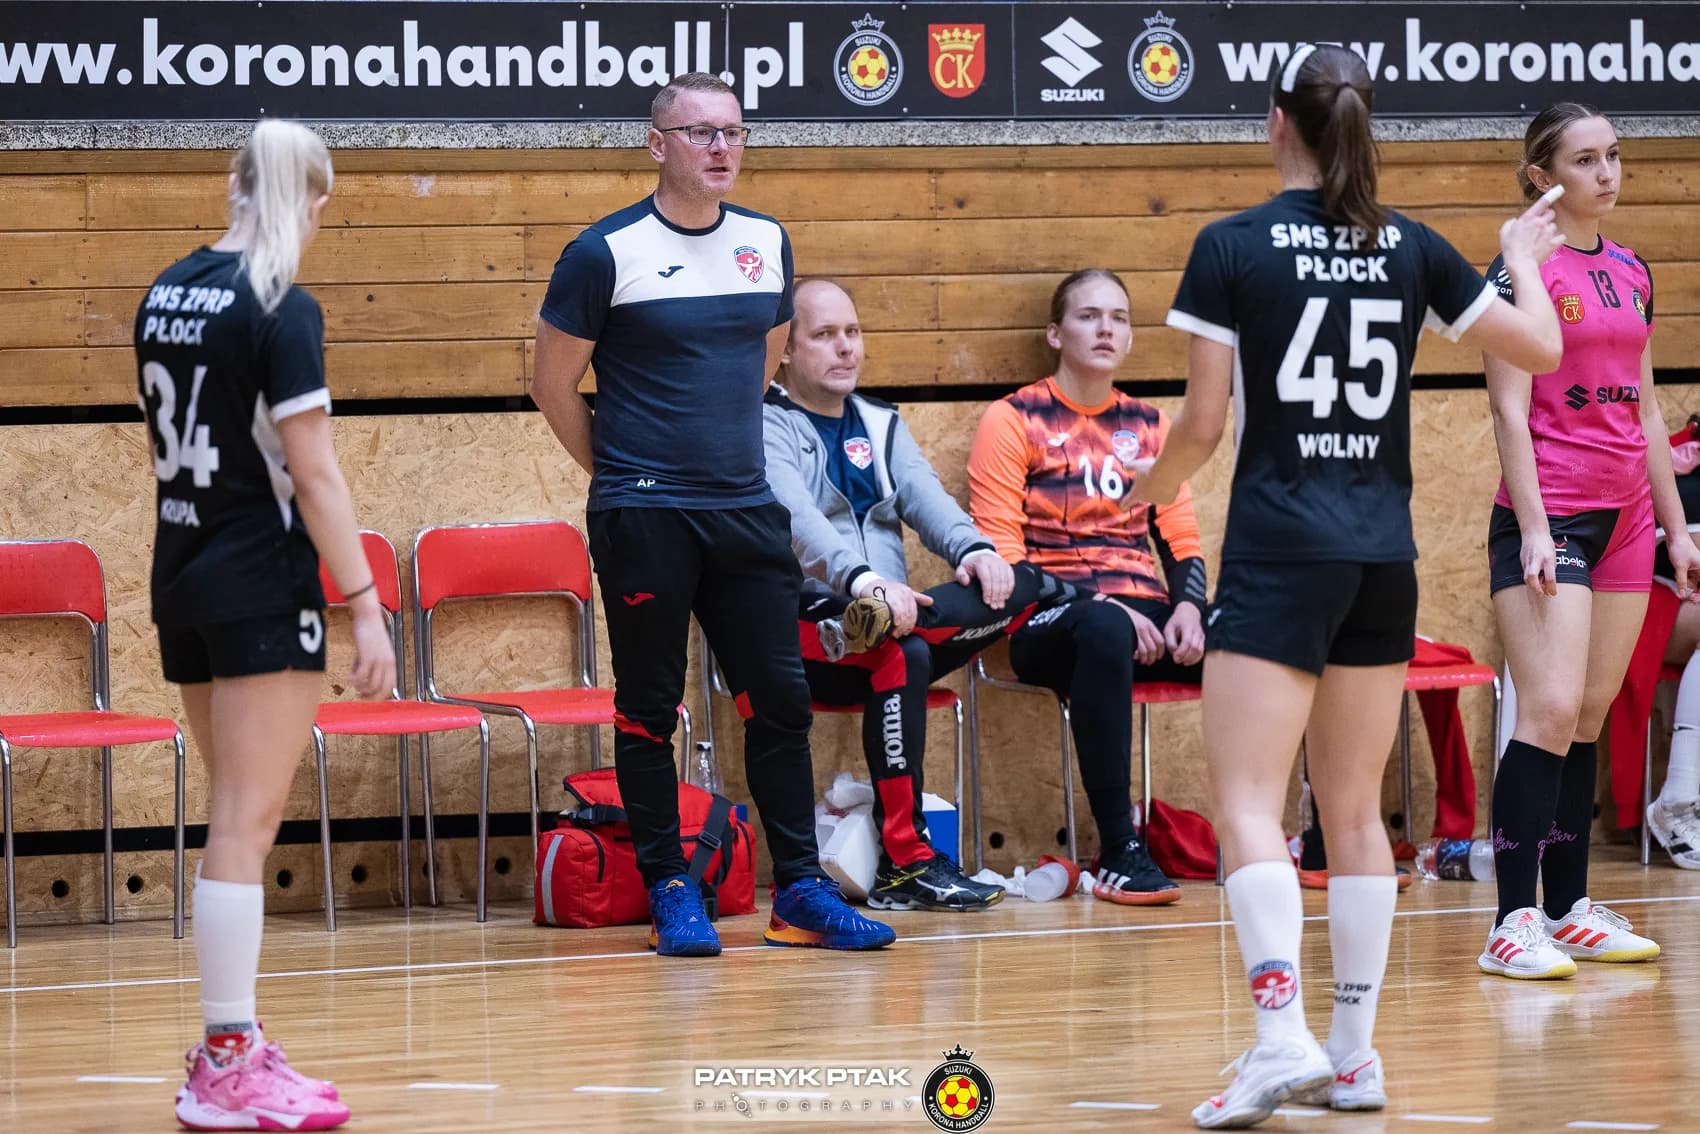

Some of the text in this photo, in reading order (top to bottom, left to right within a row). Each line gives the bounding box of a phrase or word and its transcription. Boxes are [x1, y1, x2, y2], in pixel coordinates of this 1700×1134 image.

[854, 36, 882, 47] SUZUKI
[934, 53, 975, 89] CK
[1134, 69, 1189, 96] KORONA HANDBALL
[840, 72, 897, 99] KORONA HANDBALL
[1040, 88, 1105, 102] SUZUKI
[1270, 223, 1329, 249] SMS
[1296, 254, 1388, 282] PŁOCK
[180, 286, 236, 314] ZPRP
[1587, 269, 1622, 308] 13
[1563, 305, 1582, 321] CK
[1276, 297, 1403, 420] 45
[142, 361, 219, 488] 34
[1297, 433, 1380, 460] WOLNY
[636, 478, 656, 488] AP
[1078, 454, 1124, 500] 16
